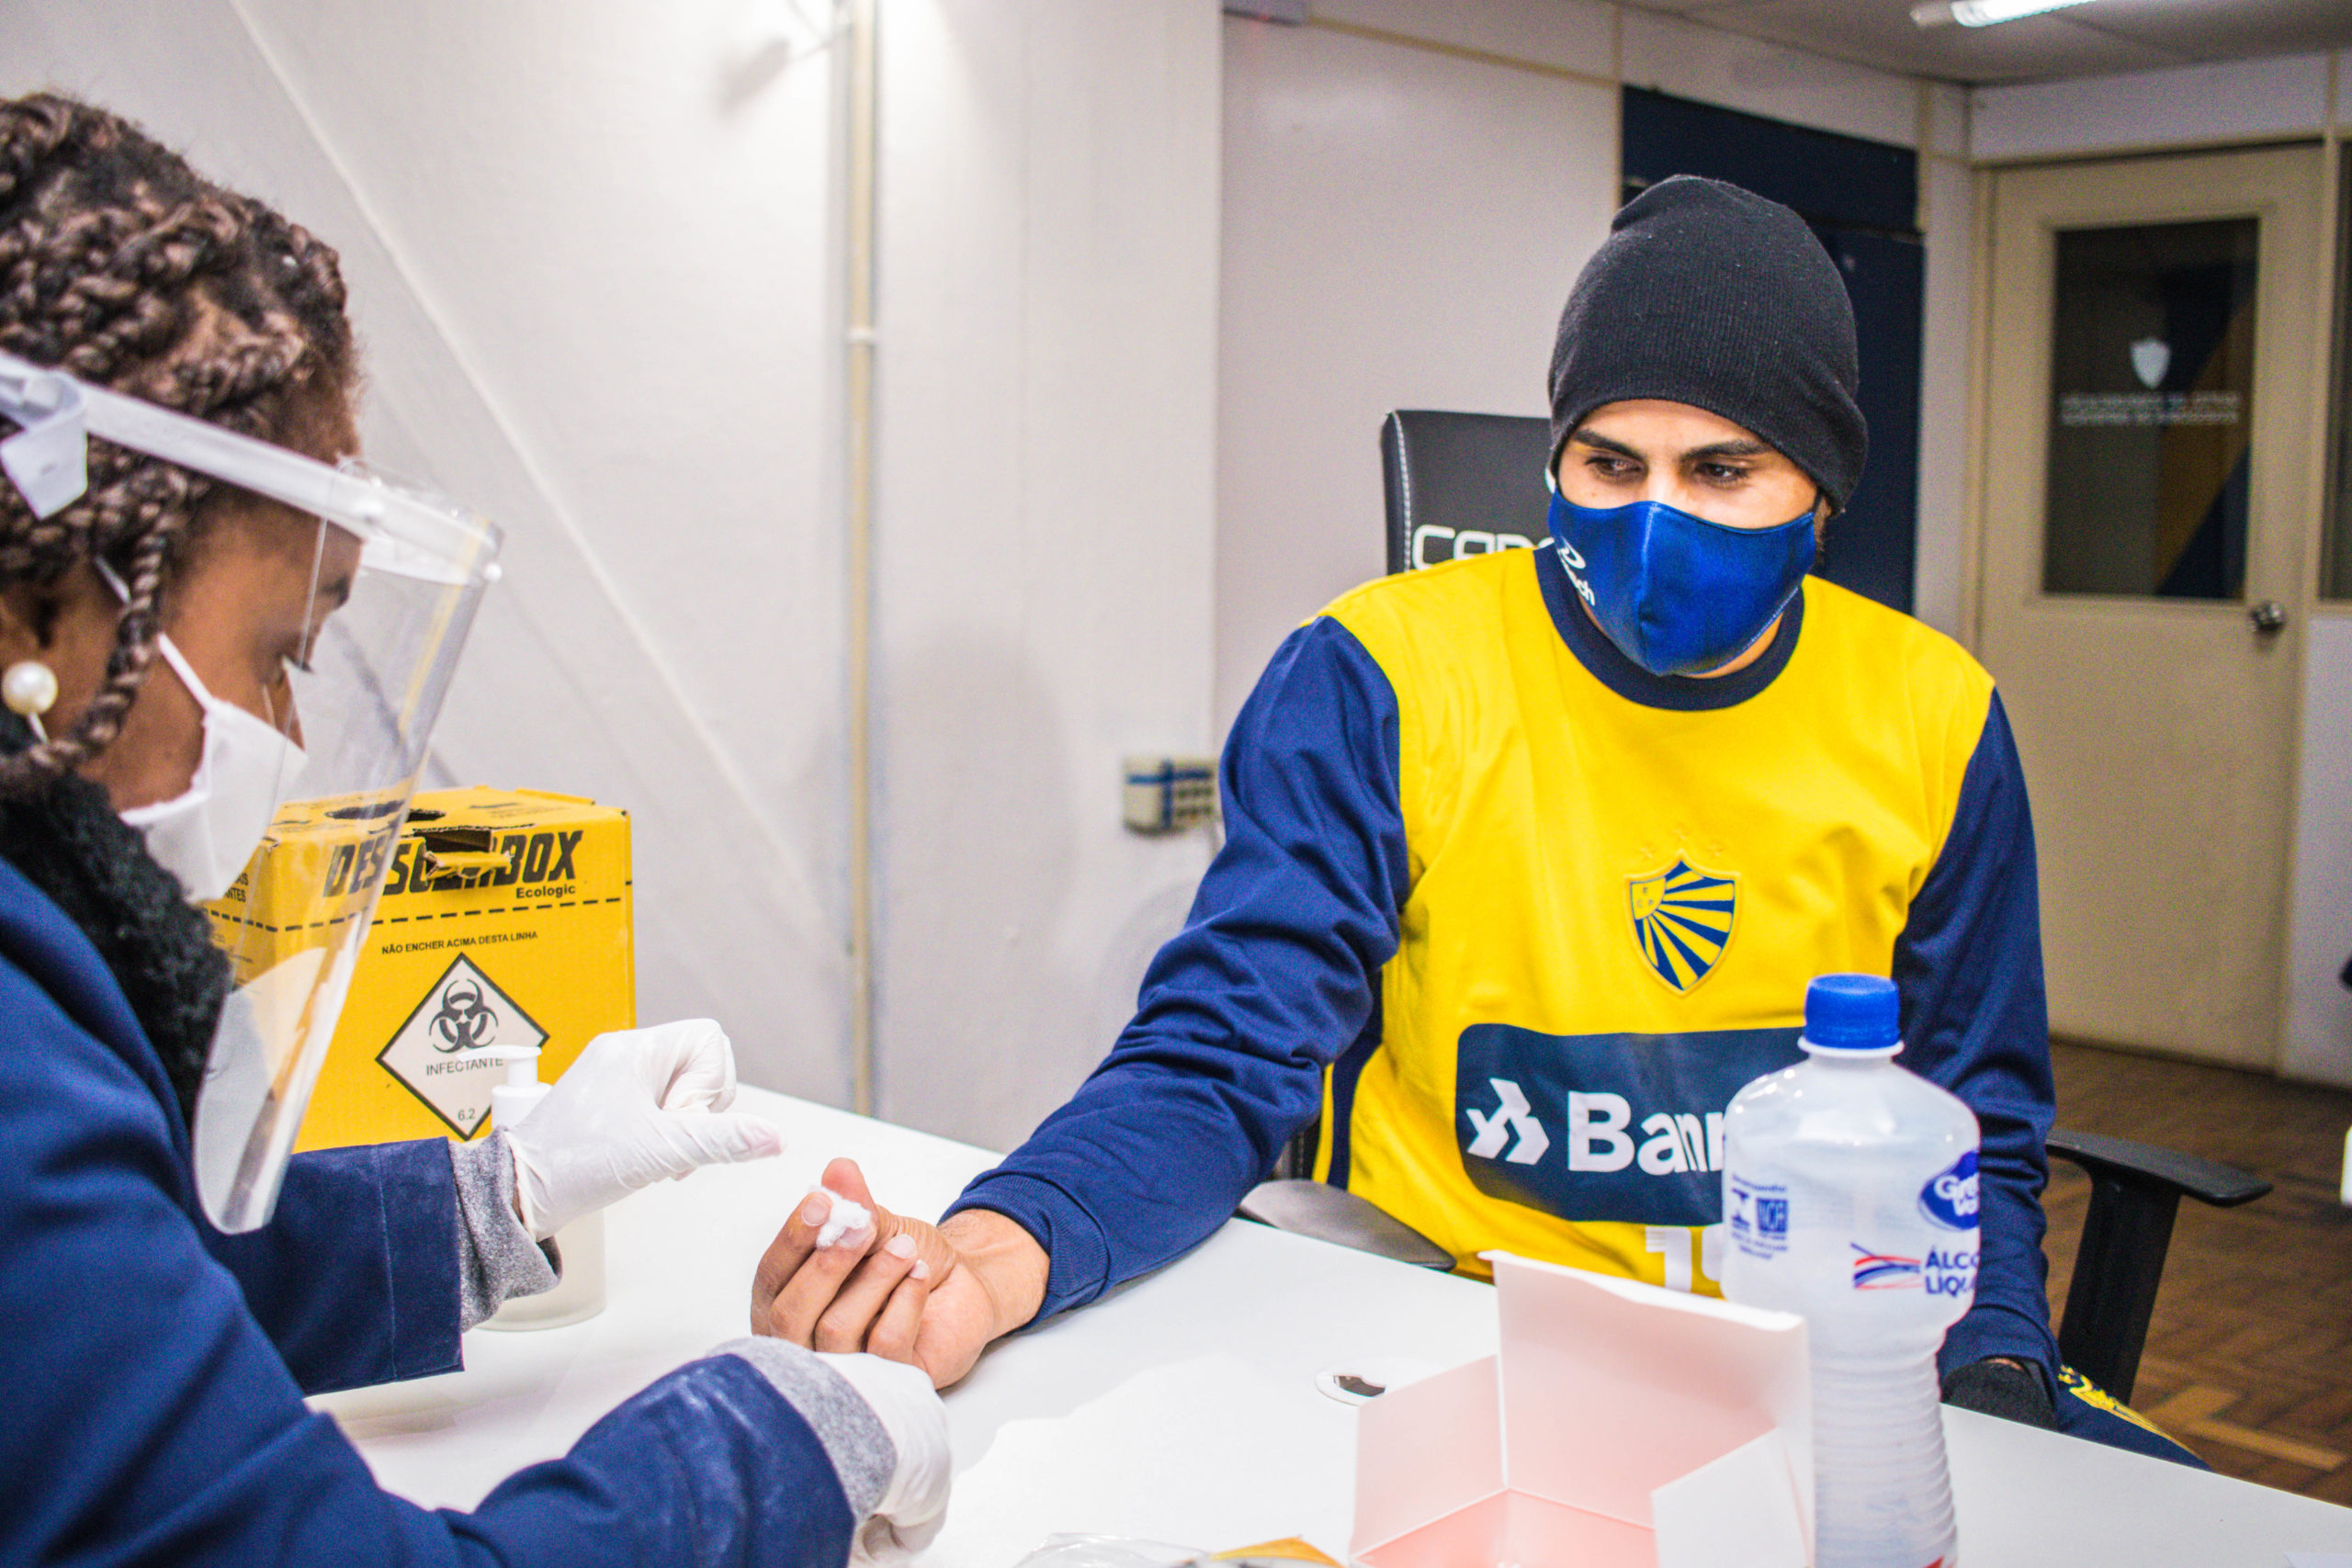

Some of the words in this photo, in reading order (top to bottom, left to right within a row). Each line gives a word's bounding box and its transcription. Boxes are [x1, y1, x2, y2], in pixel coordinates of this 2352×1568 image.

[322, 830, 583, 897] DESCBOX
[516, 885, 576, 899] Ecologic
[381, 942, 403, 955] NÃO
[405, 940, 445, 953] ENCHER
[447, 936, 476, 949] ACIMA
[478, 933, 509, 944] DESTA
[510, 931, 538, 942] LINHA
[425, 1057, 504, 1077] INFECTANTE
[458, 1107, 476, 1122] 6.2
